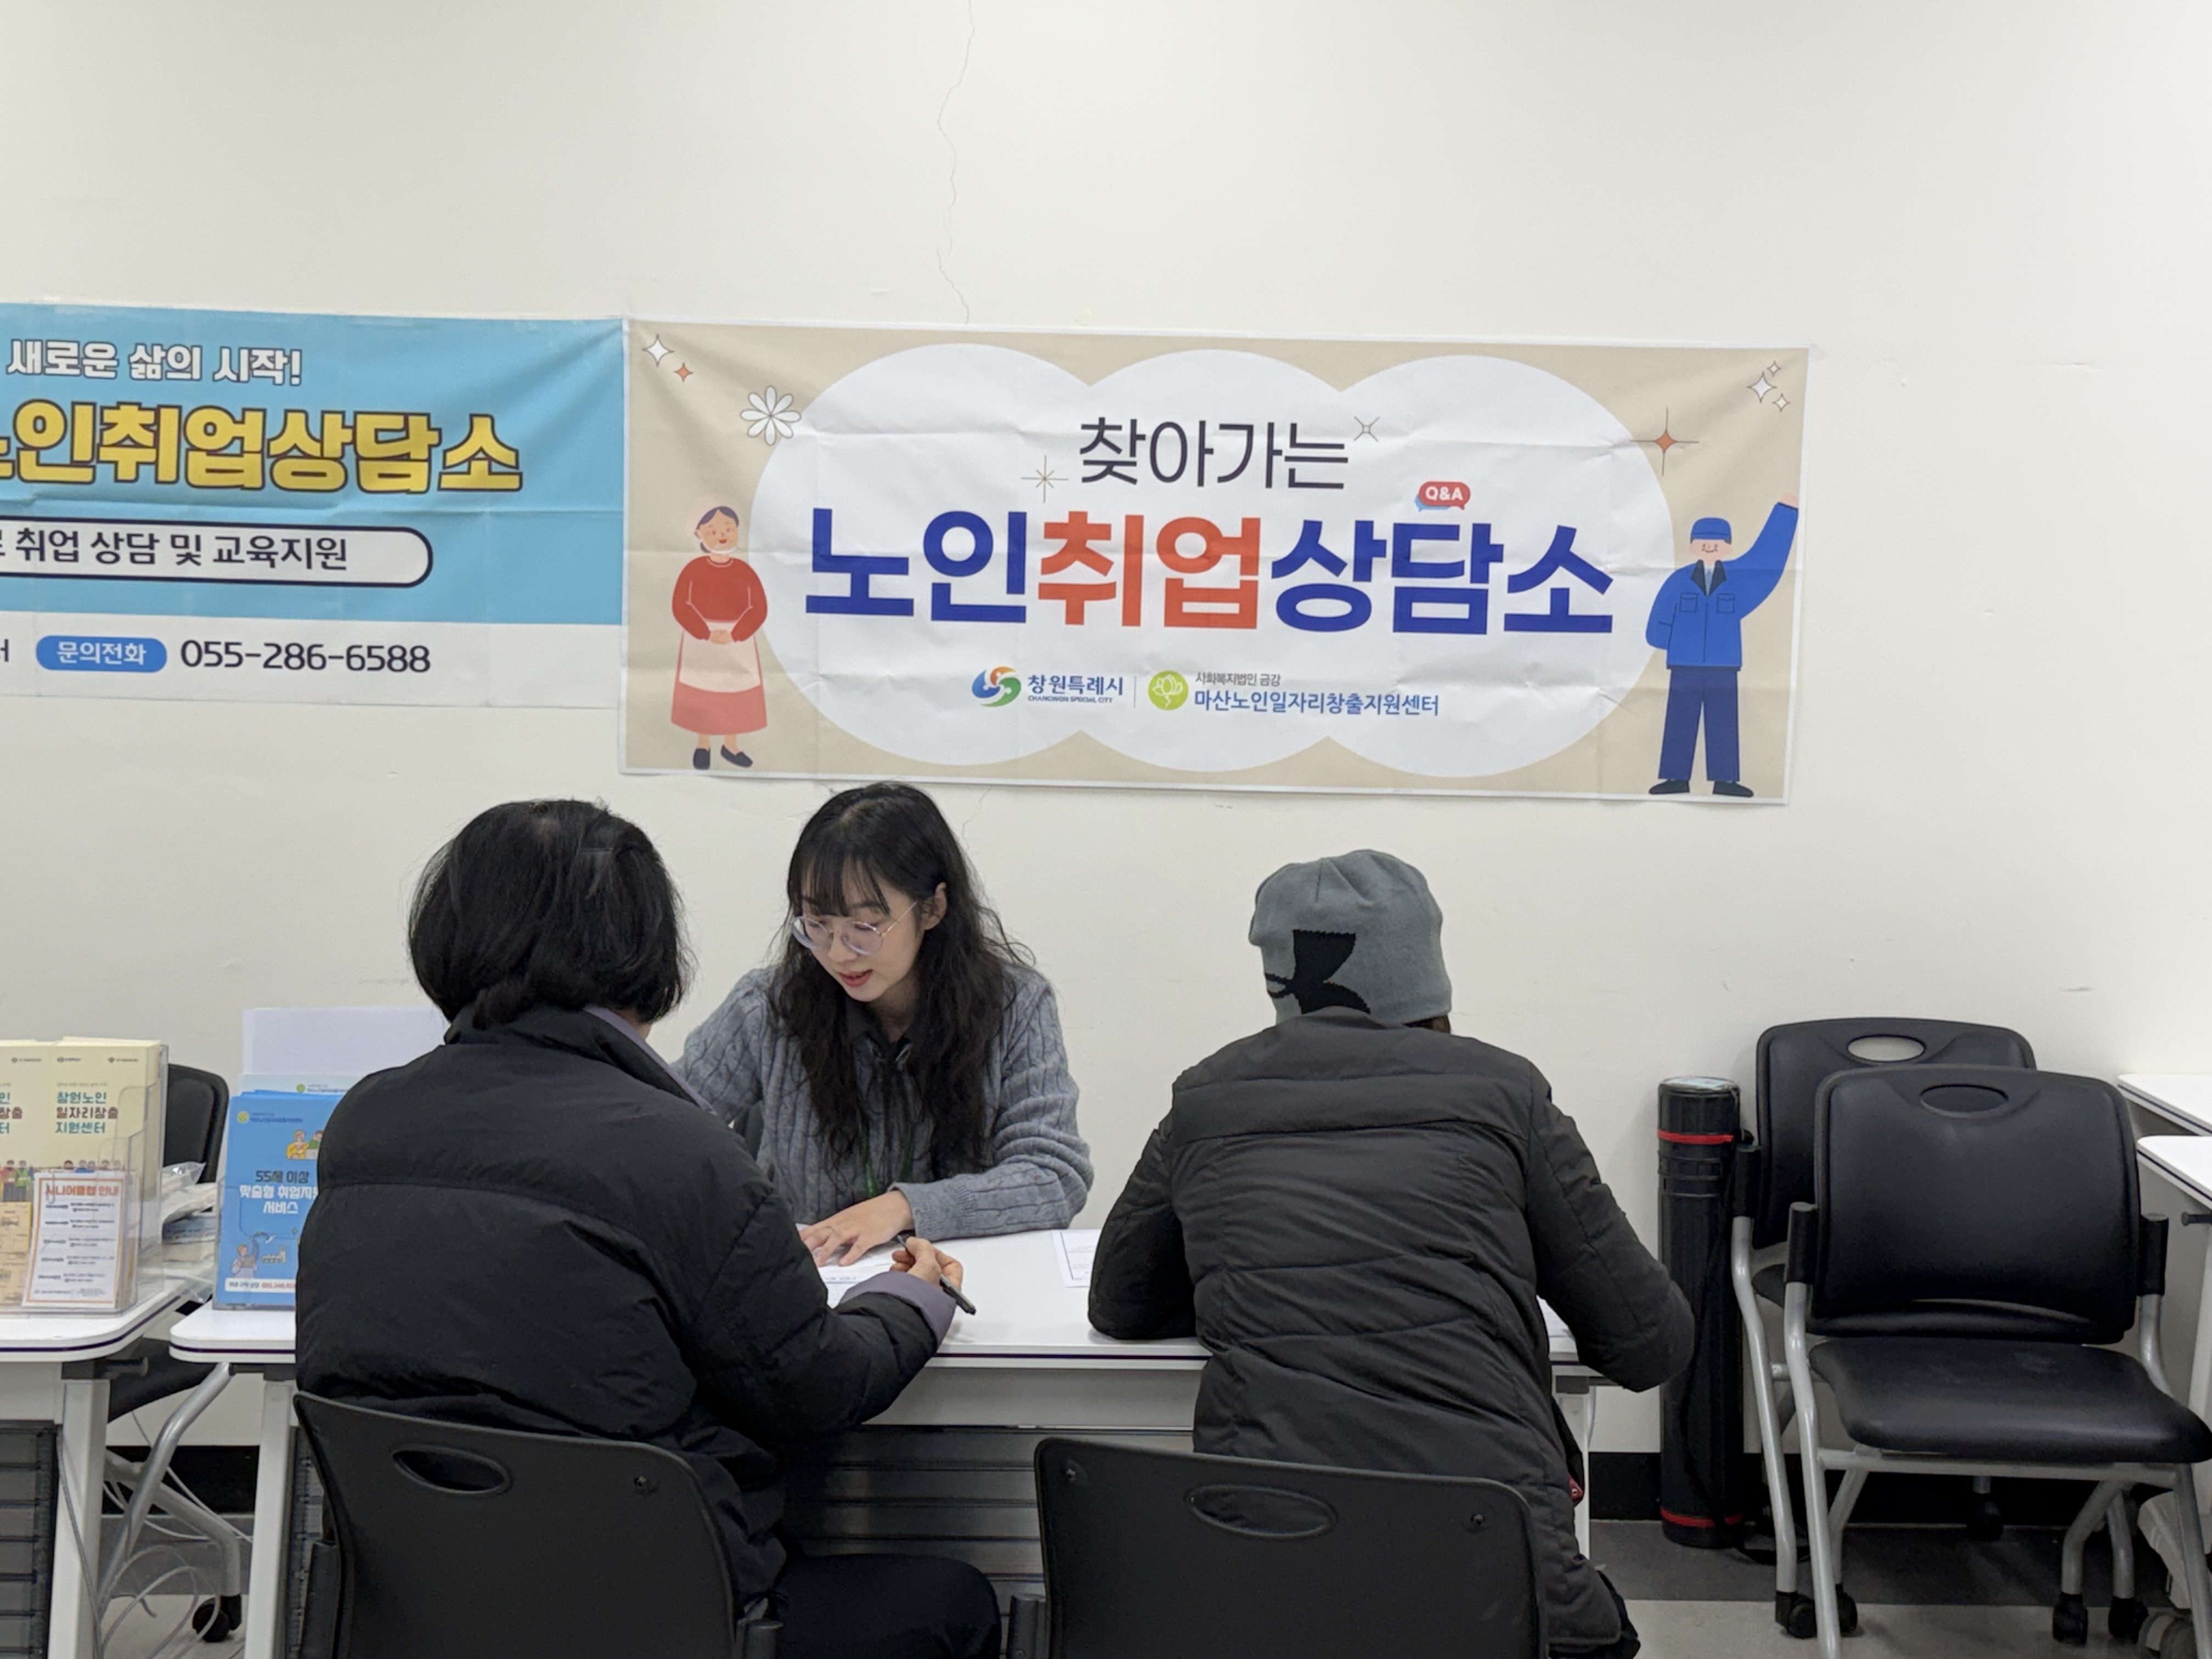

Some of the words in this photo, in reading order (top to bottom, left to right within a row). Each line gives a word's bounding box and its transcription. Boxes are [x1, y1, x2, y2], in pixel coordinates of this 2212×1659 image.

[6, 338, 119, 379] 새로운
[128, 342, 202, 381] 삶의
[213, 346, 302, 386] 시작!
[0, 398, 523, 494] 인취업상담소
[1079, 416, 1348, 490] 찾아가는
[1425, 486, 1464, 501] Q&A
[16, 527, 80, 563] 취업
[91, 532, 160, 565] 상담
[170, 534, 202, 566] 및
[213, 535, 347, 571] 교육지원
[805, 507, 1613, 636] 노인취업상담소
[57, 641, 147, 665] 문의전화
[180, 640, 431, 673] 055-286-6588
[1028, 674, 1124, 696] 창원특례시
[1195, 672, 1257, 686] 사회복지법인
[1260, 673, 1281, 687] 금강
[1194, 690, 1440, 715] 마산노인일자리창출지원센터
[55, 1122, 105, 1133] 지원센터
[286, 1171, 309, 1184] 이상
[263, 1201, 298, 1214] 서비스
